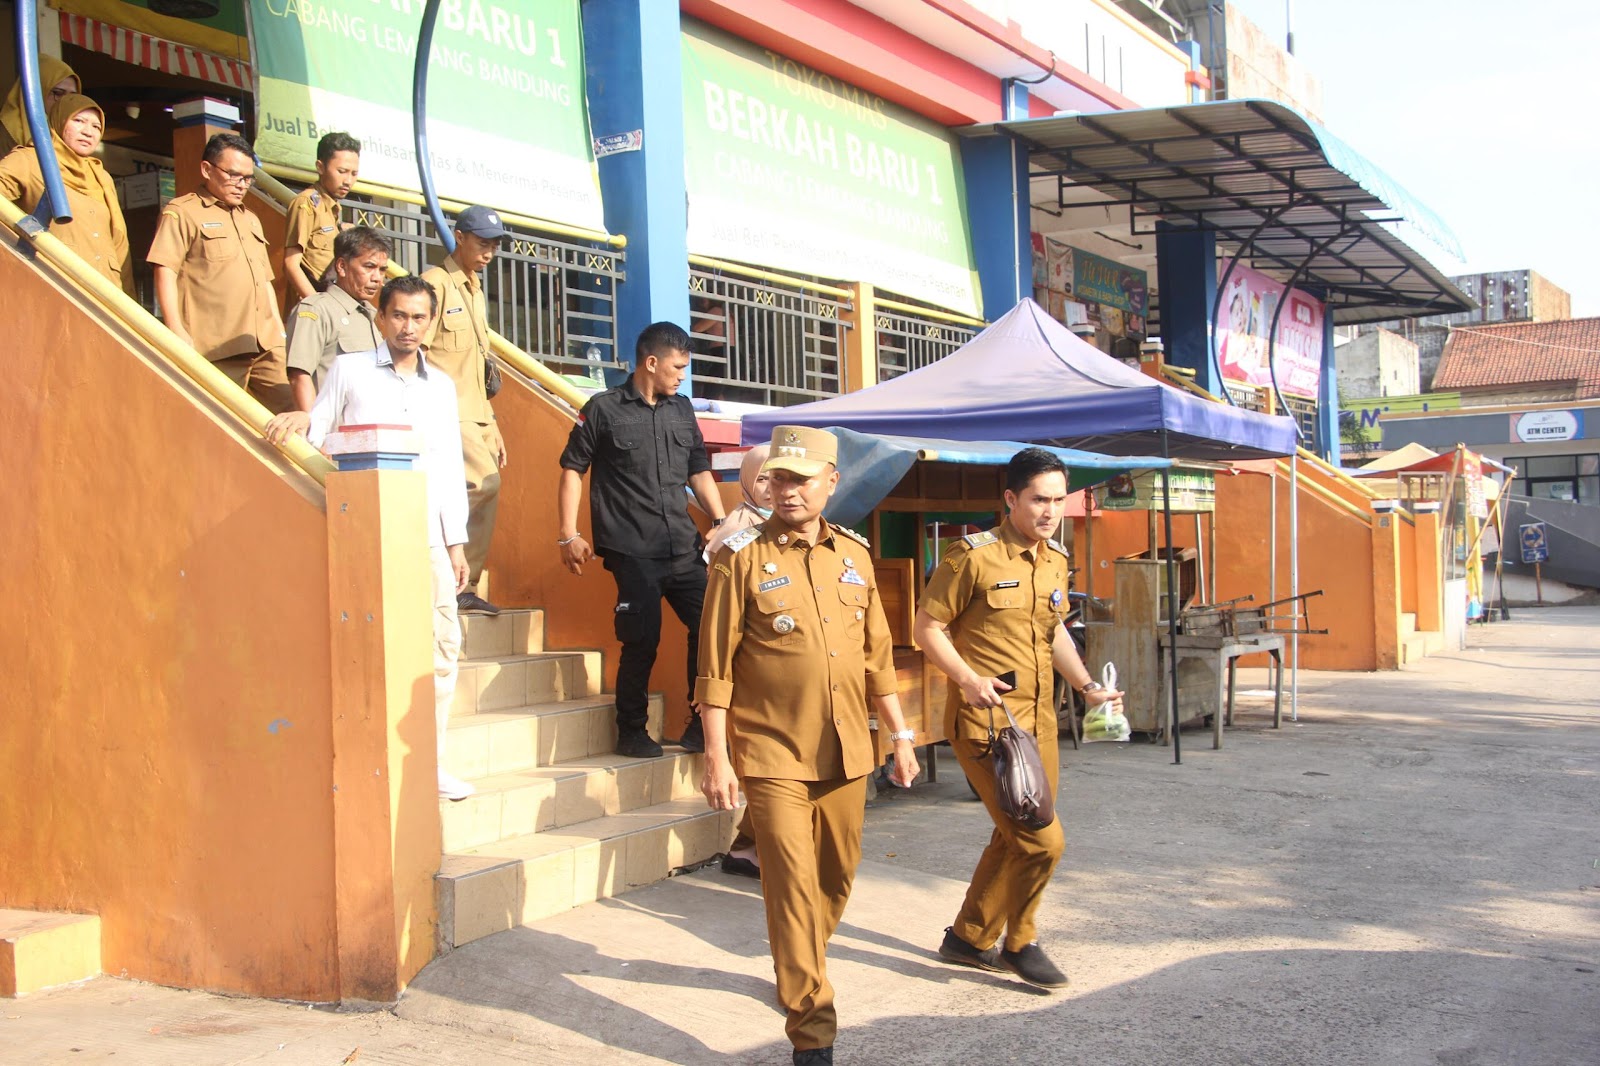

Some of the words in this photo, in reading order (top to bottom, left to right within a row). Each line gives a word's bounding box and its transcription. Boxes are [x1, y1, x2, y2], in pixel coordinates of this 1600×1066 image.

[266, 0, 367, 42] CABANG
[373, 23, 473, 77] LEMANG
[479, 57, 571, 106] BANDUNG
[442, 0, 537, 57] BARU
[546, 27, 566, 67] 1
[765, 51, 836, 110] TOKO
[842, 81, 888, 130] MAS
[265, 112, 301, 137] Jual
[456, 158, 468, 174] &
[472, 160, 538, 192] Menerima
[541, 179, 590, 204] Pesanan
[703, 80, 840, 170] BERKAH
[846, 131, 920, 198] BARU
[926, 164, 944, 205] 1
[1527, 427, 1540, 435] ATM
[1542, 426, 1566, 434] CENTER
